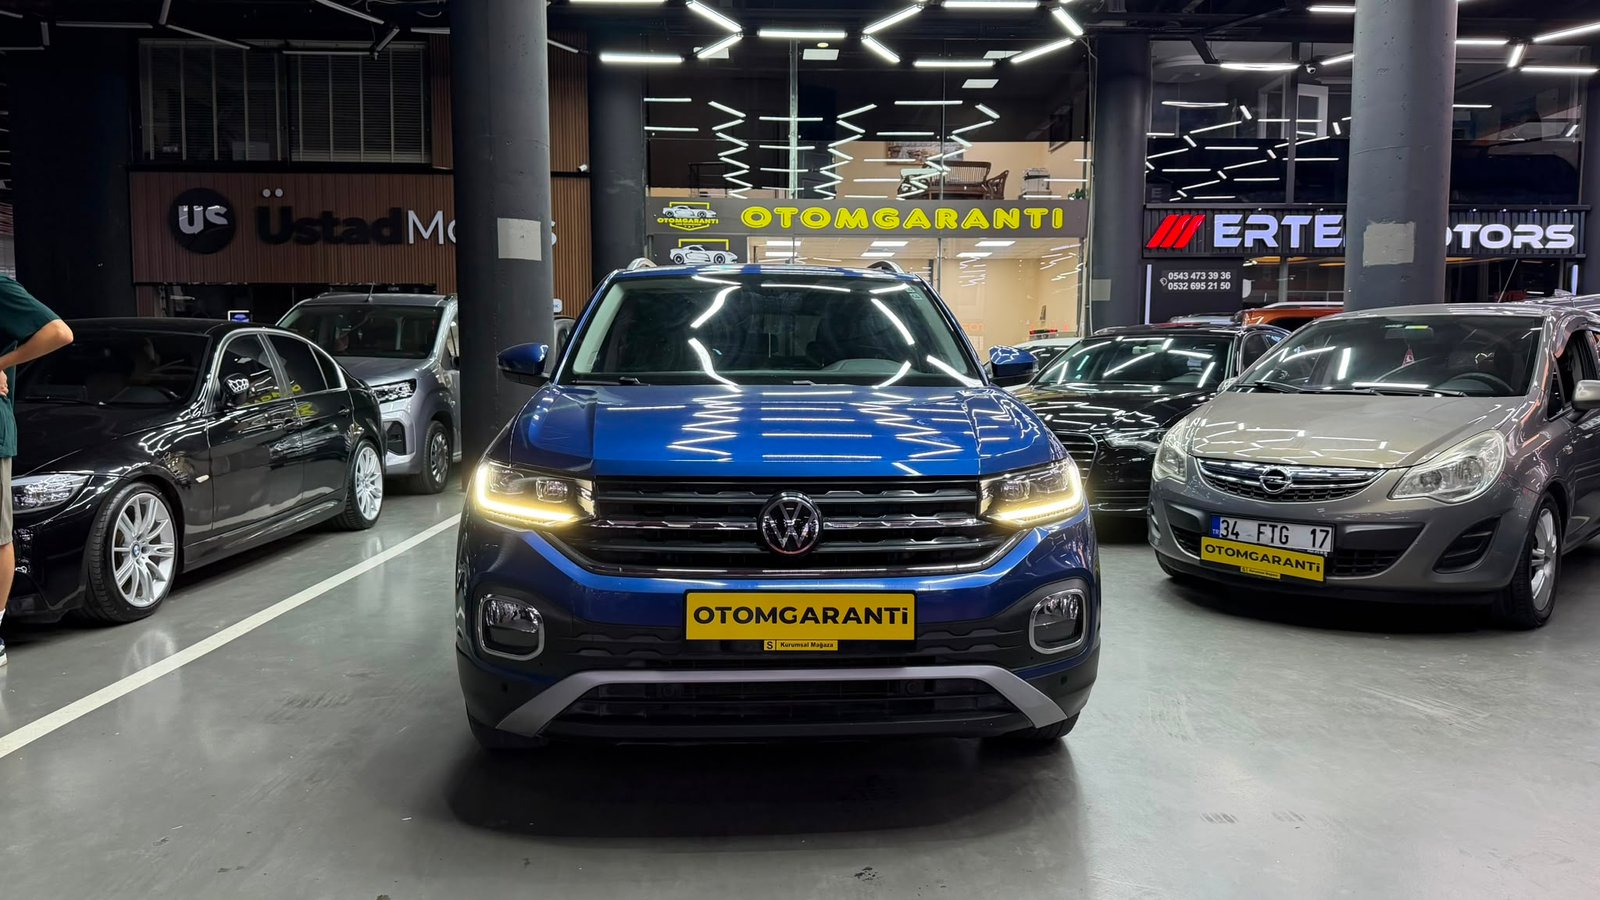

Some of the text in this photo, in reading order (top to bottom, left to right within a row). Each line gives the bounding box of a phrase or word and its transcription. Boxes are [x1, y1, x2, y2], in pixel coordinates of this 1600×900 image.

[740, 206, 1064, 230] OTOMGARANTI
[1213, 214, 1576, 249] ERTE TORS
[1168, 272, 1231, 280] 0543 473 39 36
[1167, 282, 1231, 291] 0532 695 21 50
[1220, 519, 1330, 549] 34 FTG 17
[766, 641, 774, 650] S
